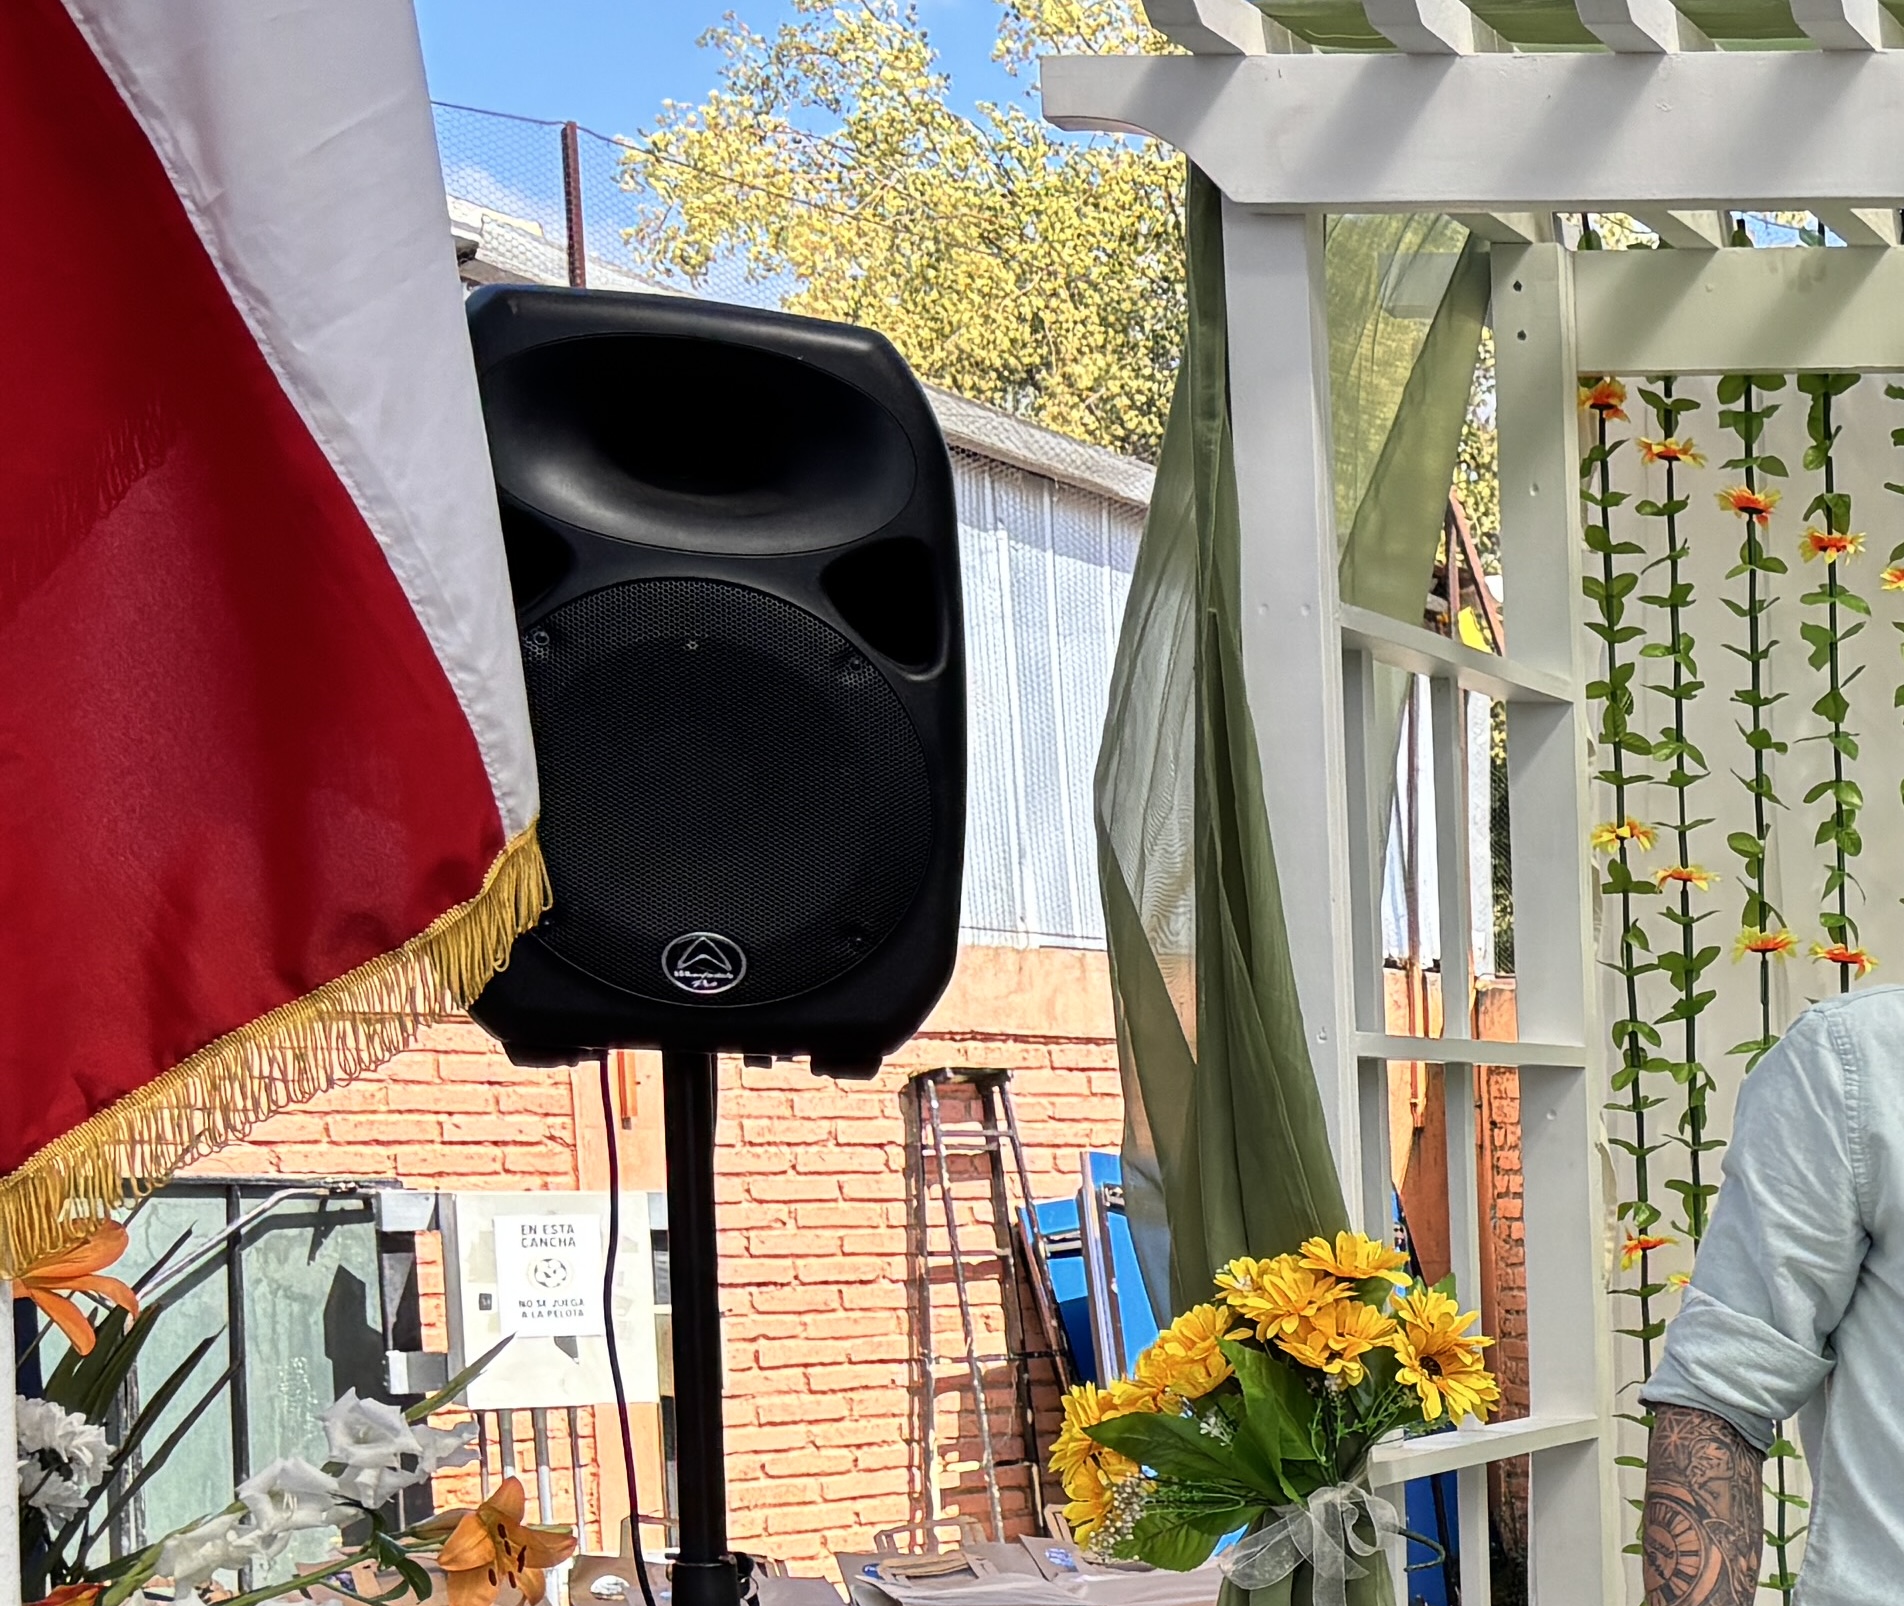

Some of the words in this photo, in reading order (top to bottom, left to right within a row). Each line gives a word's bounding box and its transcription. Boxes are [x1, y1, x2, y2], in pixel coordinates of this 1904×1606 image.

[521, 1224, 537, 1235] EN
[543, 1224, 575, 1235] ESTA
[521, 1237, 576, 1248] CANCHA
